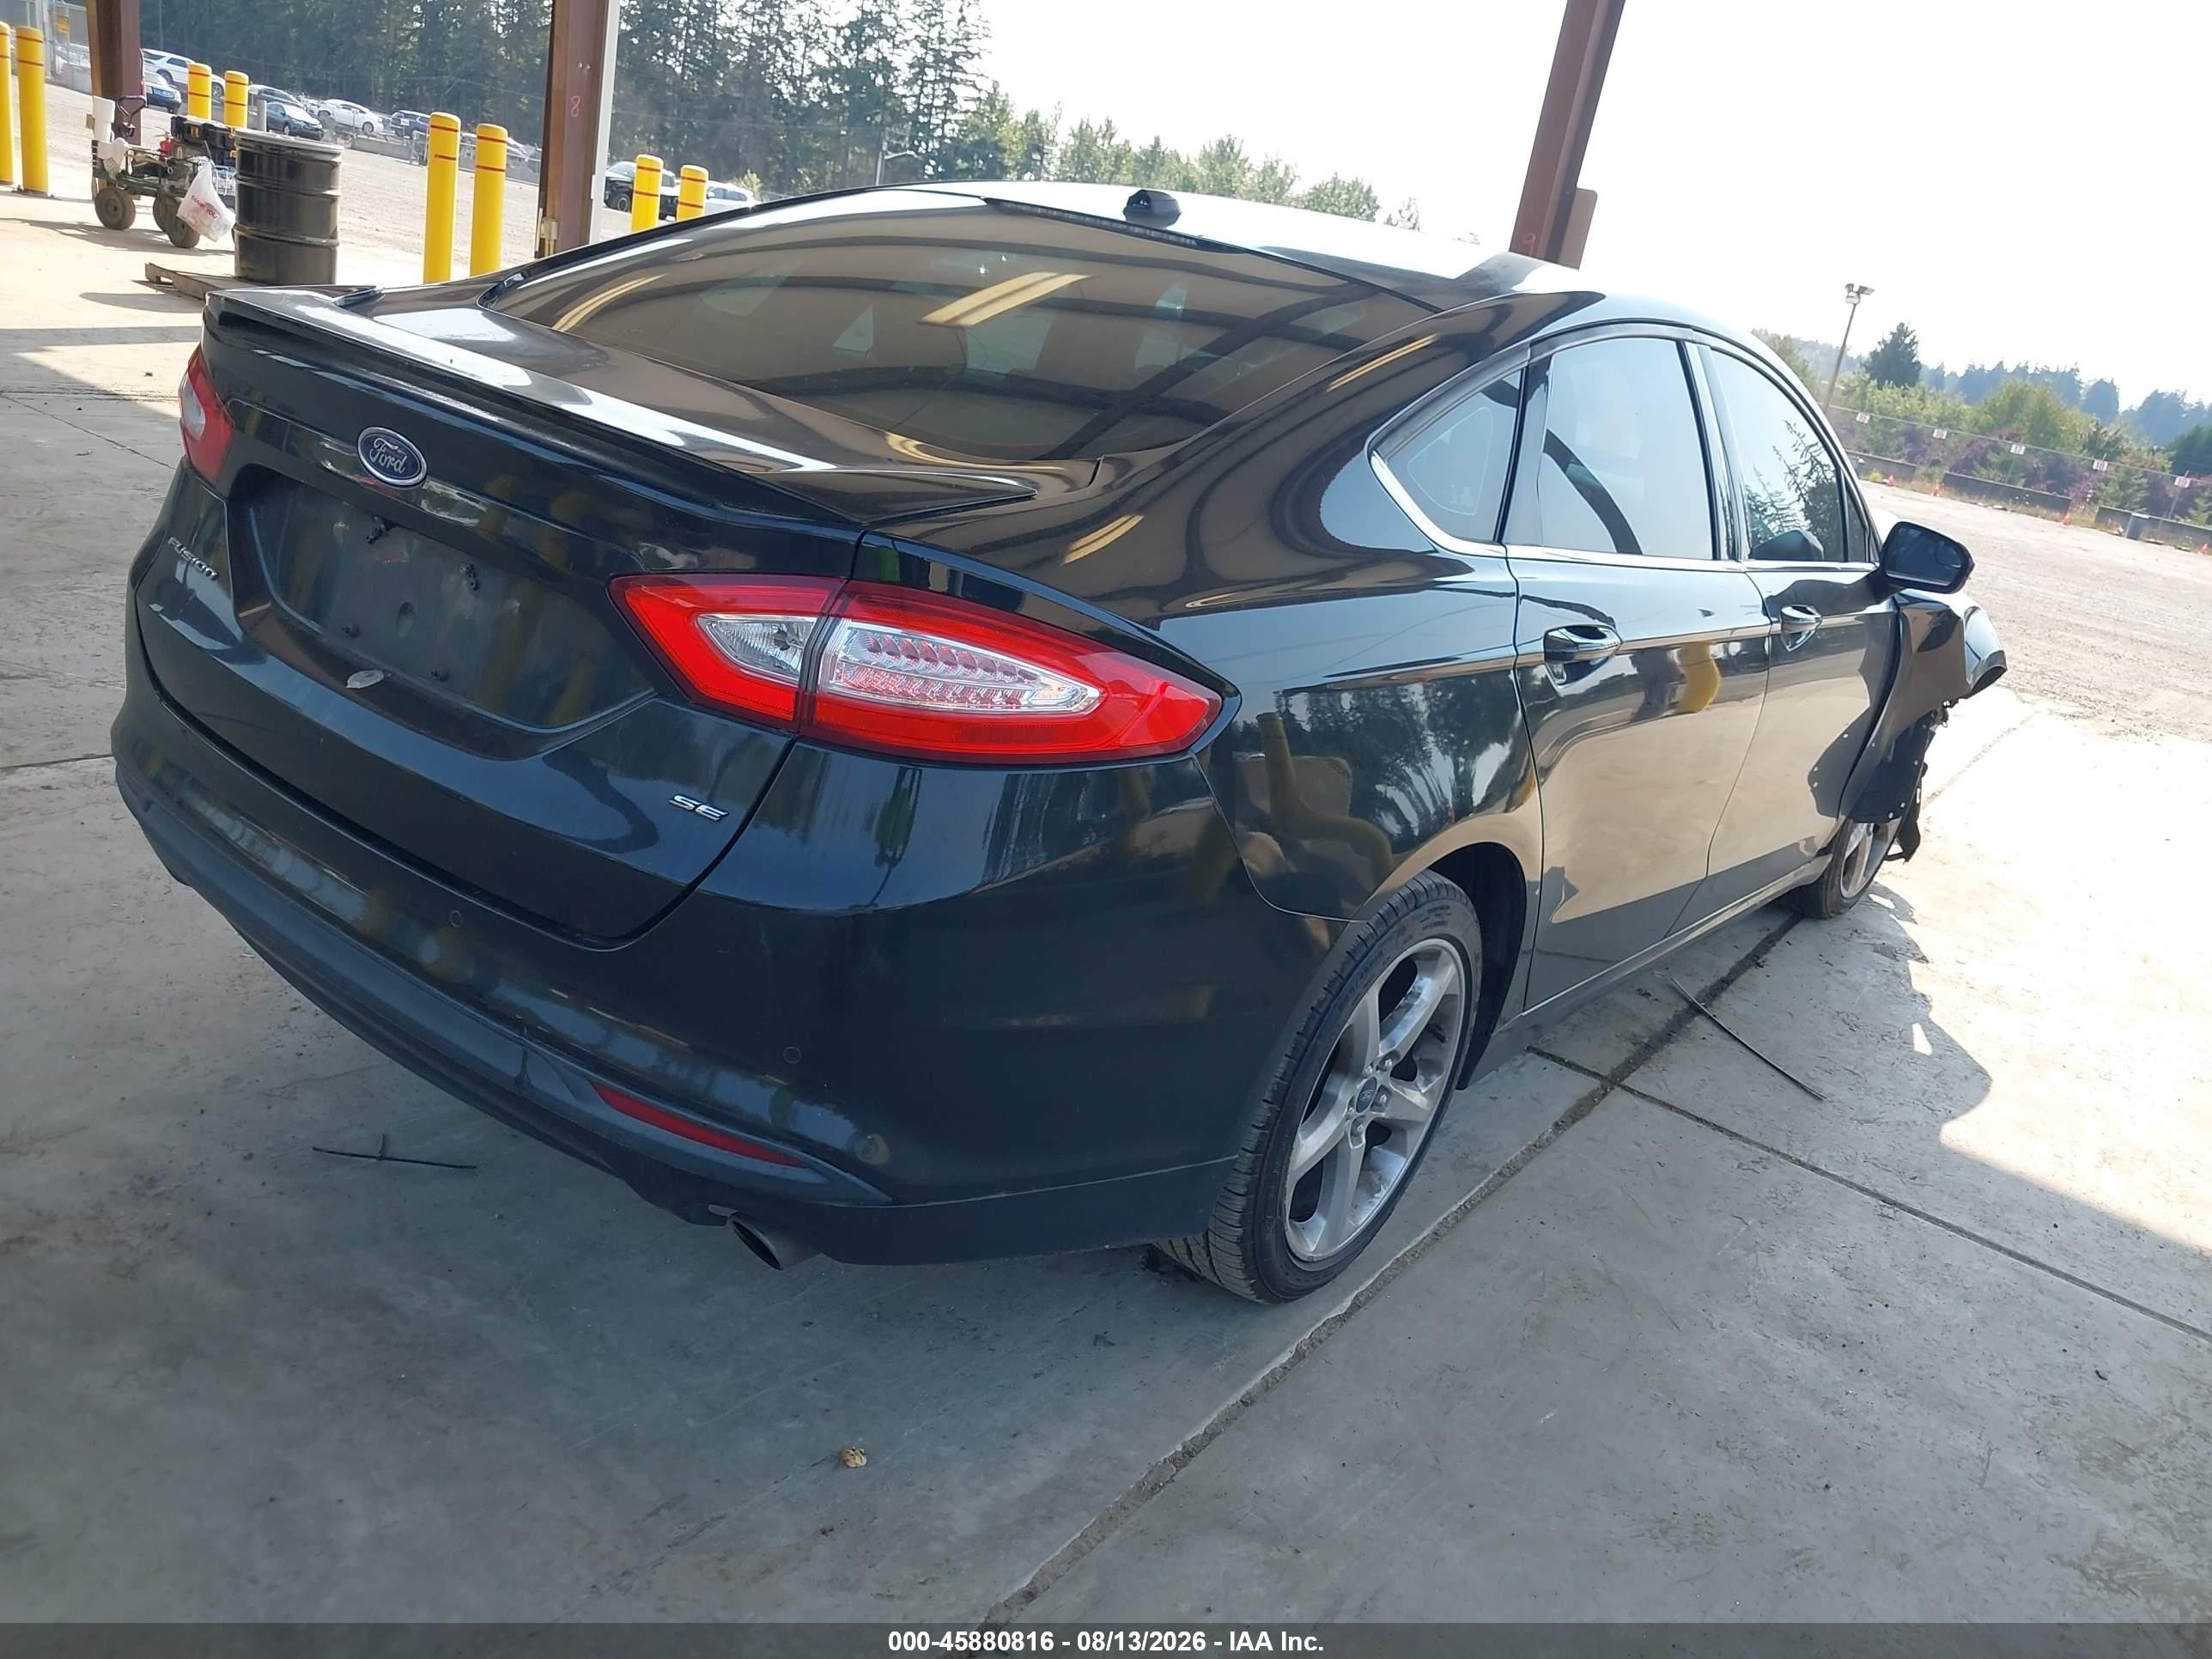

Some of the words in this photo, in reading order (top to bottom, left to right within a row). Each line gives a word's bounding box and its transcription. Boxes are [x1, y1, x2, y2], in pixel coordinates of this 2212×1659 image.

[570, 95, 581, 118] 8
[368, 437, 408, 474] Ford
[167, 536, 218, 579] FUSION
[669, 794, 730, 821] SE
